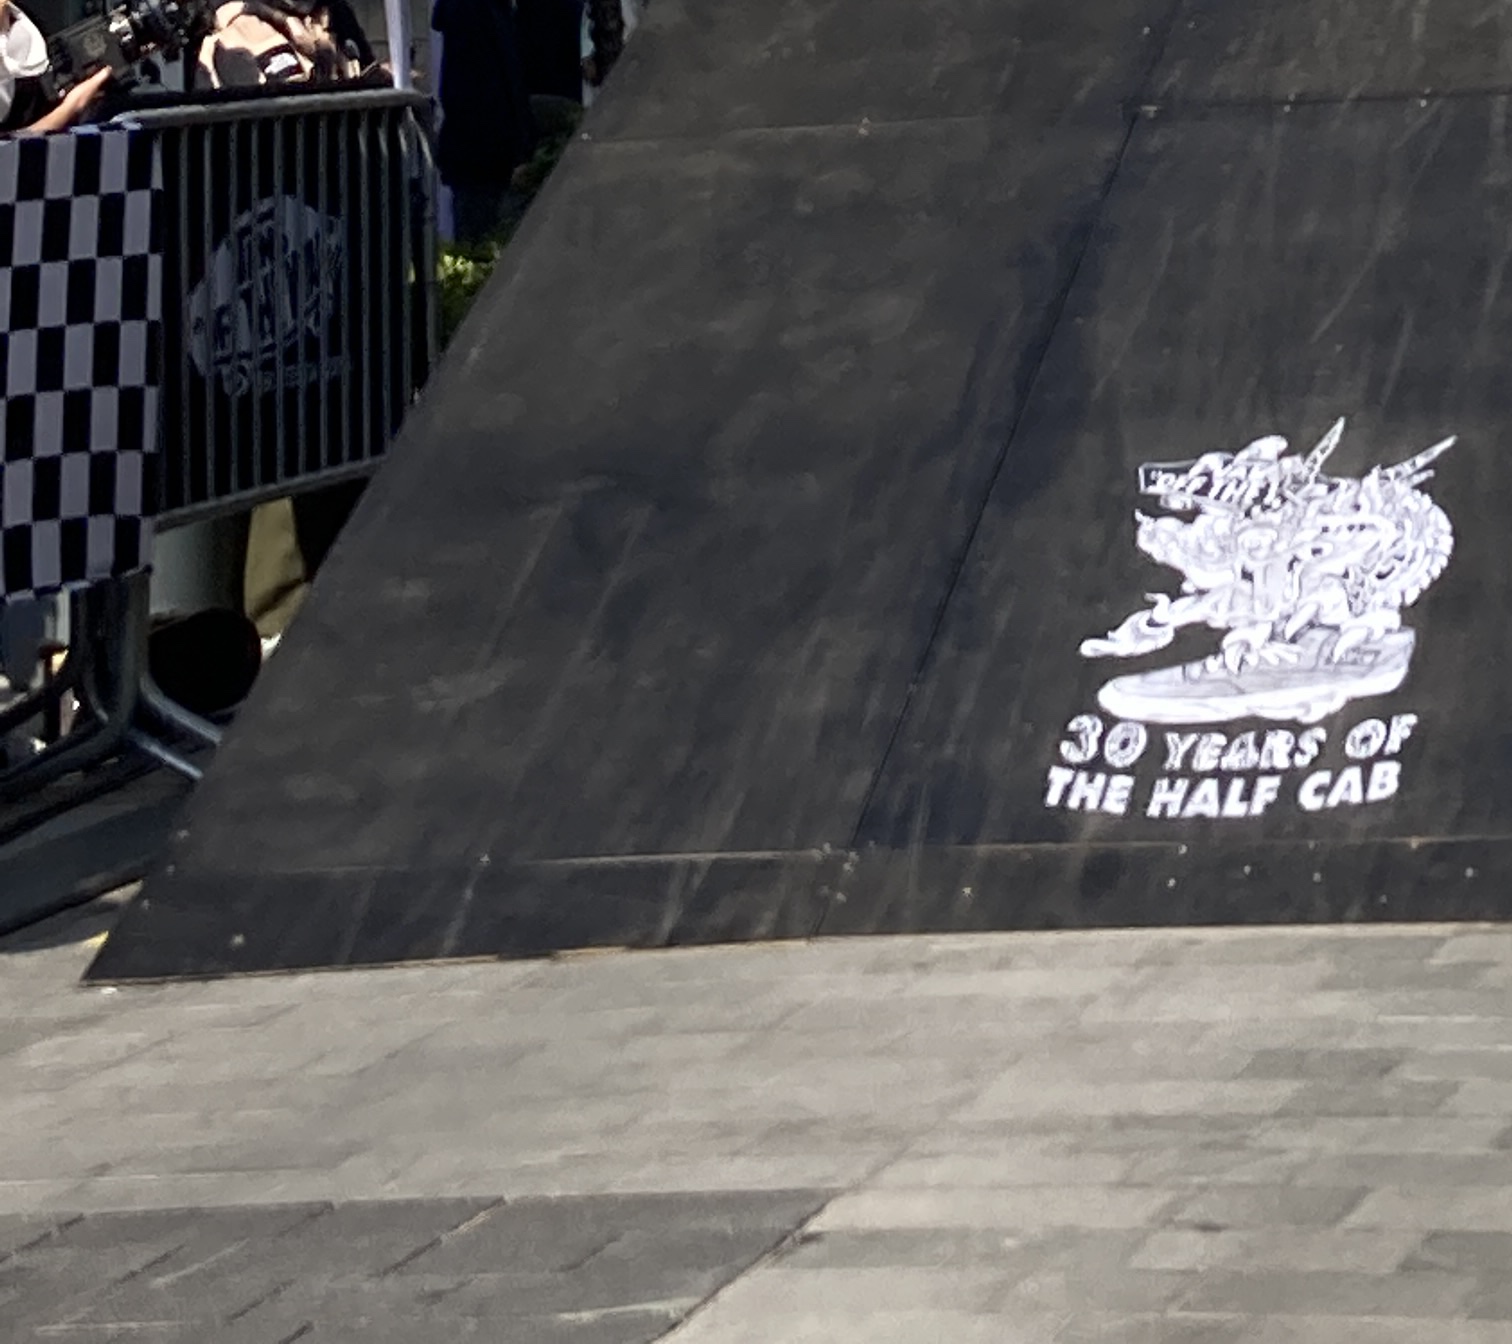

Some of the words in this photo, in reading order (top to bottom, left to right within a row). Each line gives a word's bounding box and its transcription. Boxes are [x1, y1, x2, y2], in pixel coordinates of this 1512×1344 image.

[1059, 715, 1147, 768] 30
[1163, 727, 1327, 771] YEARS
[1344, 713, 1418, 760] OF
[1045, 765, 1135, 815] THE
[1146, 774, 1282, 817] HALF
[1298, 760, 1402, 810] CAB
